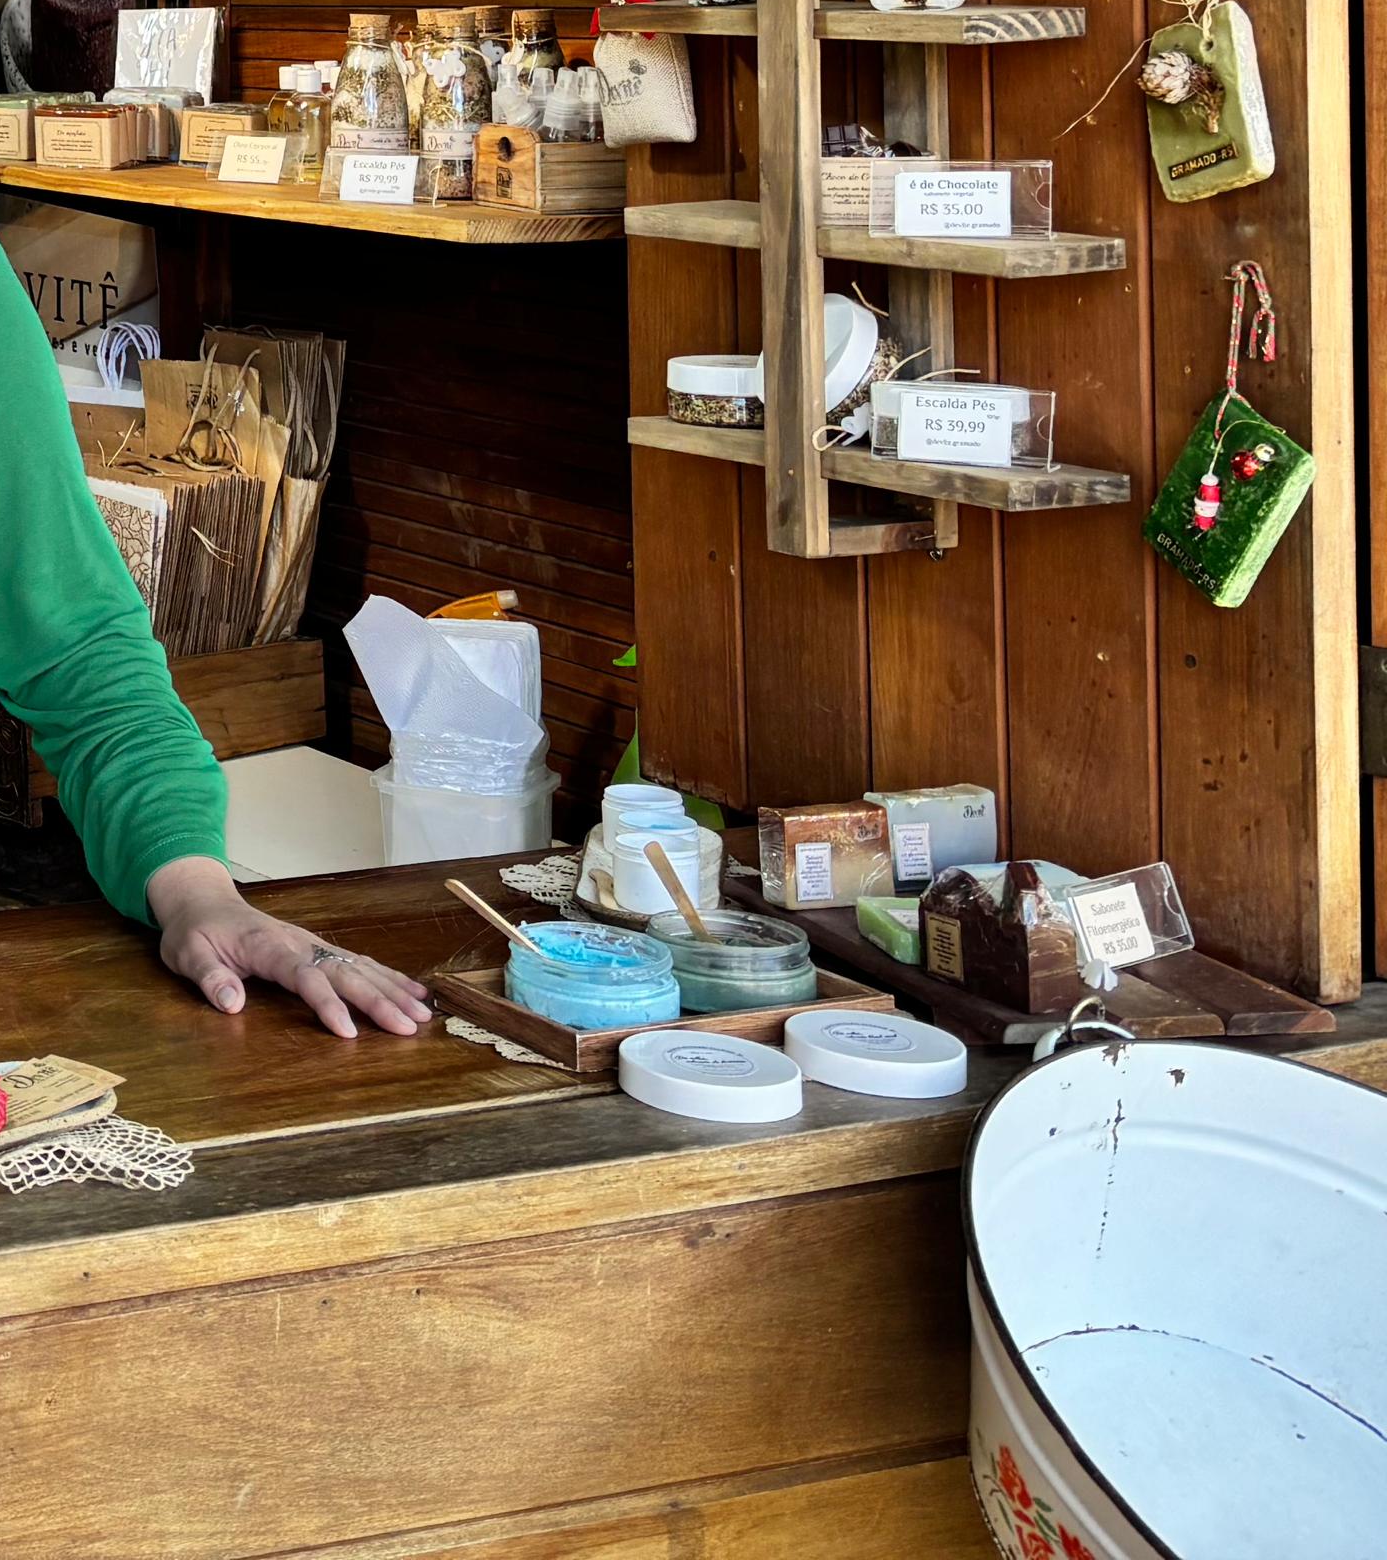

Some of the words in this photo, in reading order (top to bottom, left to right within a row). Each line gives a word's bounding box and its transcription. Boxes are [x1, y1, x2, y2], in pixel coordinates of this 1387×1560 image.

[1171, 145, 1233, 178] GRAMADO-RS
[919, 179, 934, 190] de
[937, 179, 999, 191] Chocolate
[920, 203, 939, 217] R$
[915, 395, 967, 410] Escalda
[972, 398, 996, 411] Pés
[925, 419, 943, 432] R$
[947, 420, 985, 434] 39,99
[1090, 899, 1127, 916] Sabonete
[1103, 941, 1117, 954] R$
